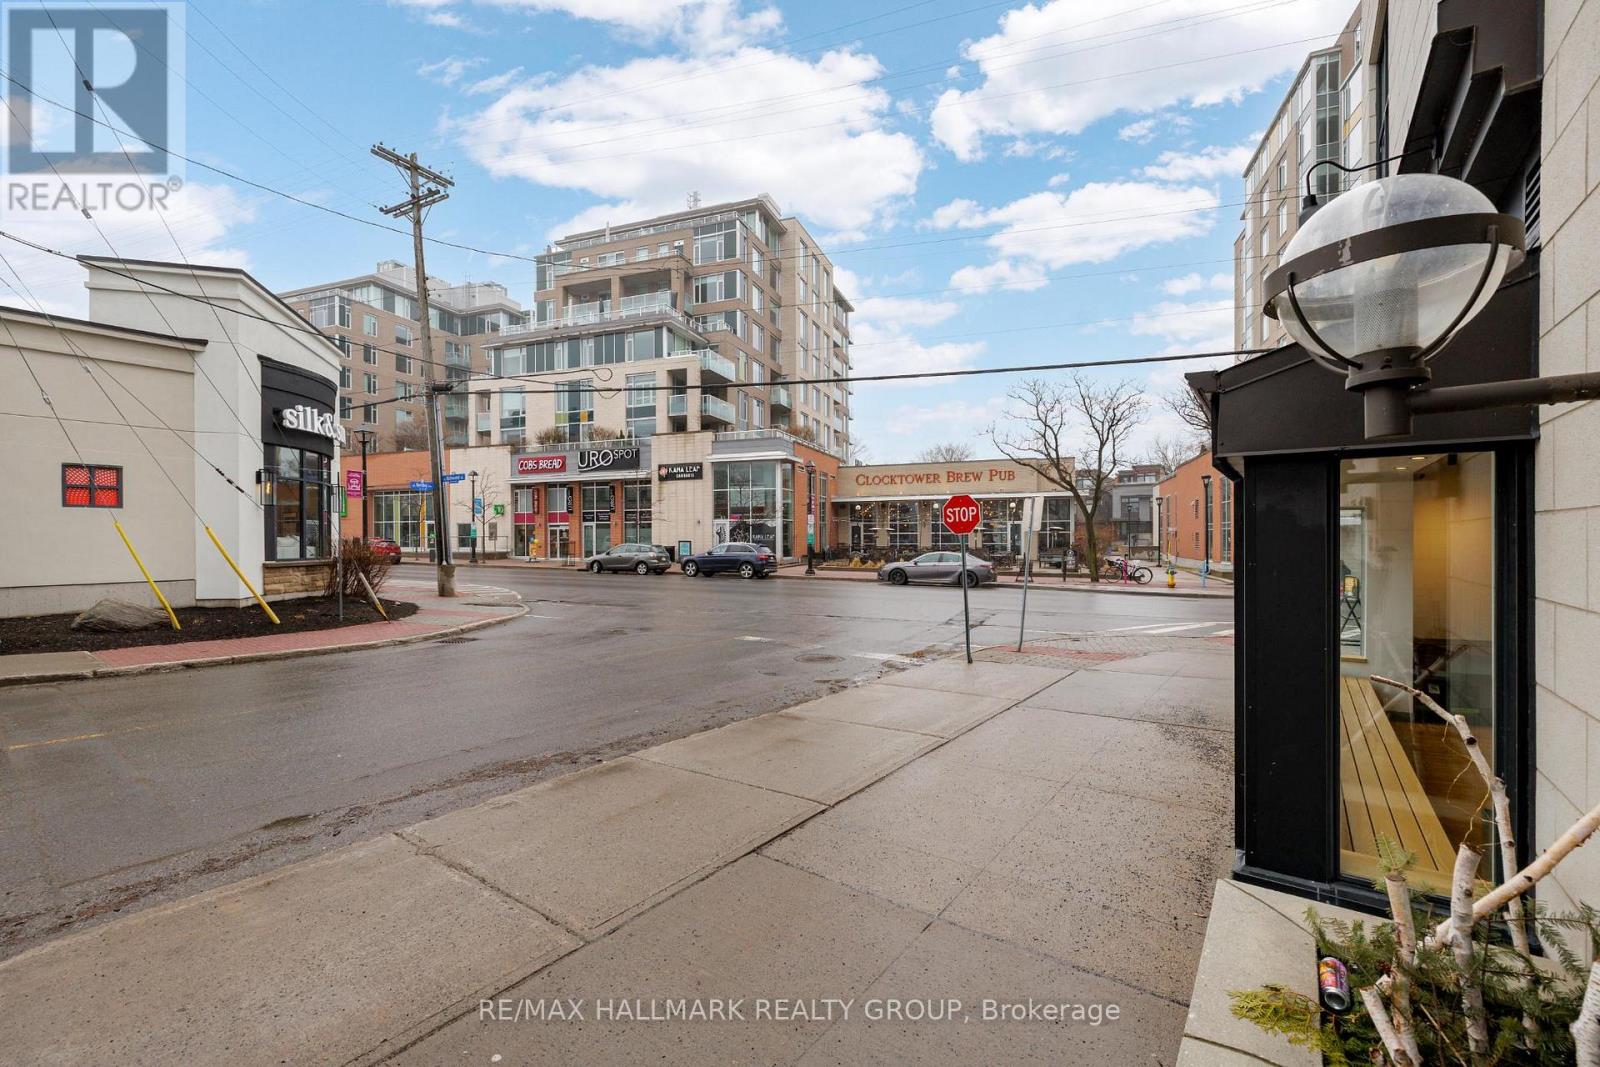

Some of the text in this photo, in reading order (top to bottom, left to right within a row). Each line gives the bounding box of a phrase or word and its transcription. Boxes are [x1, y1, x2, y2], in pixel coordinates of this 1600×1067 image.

[518, 458, 562, 471] COBS BREAD
[855, 469, 1016, 486] CLOCKTOWER BREW PUB
[946, 506, 977, 523] STOP
